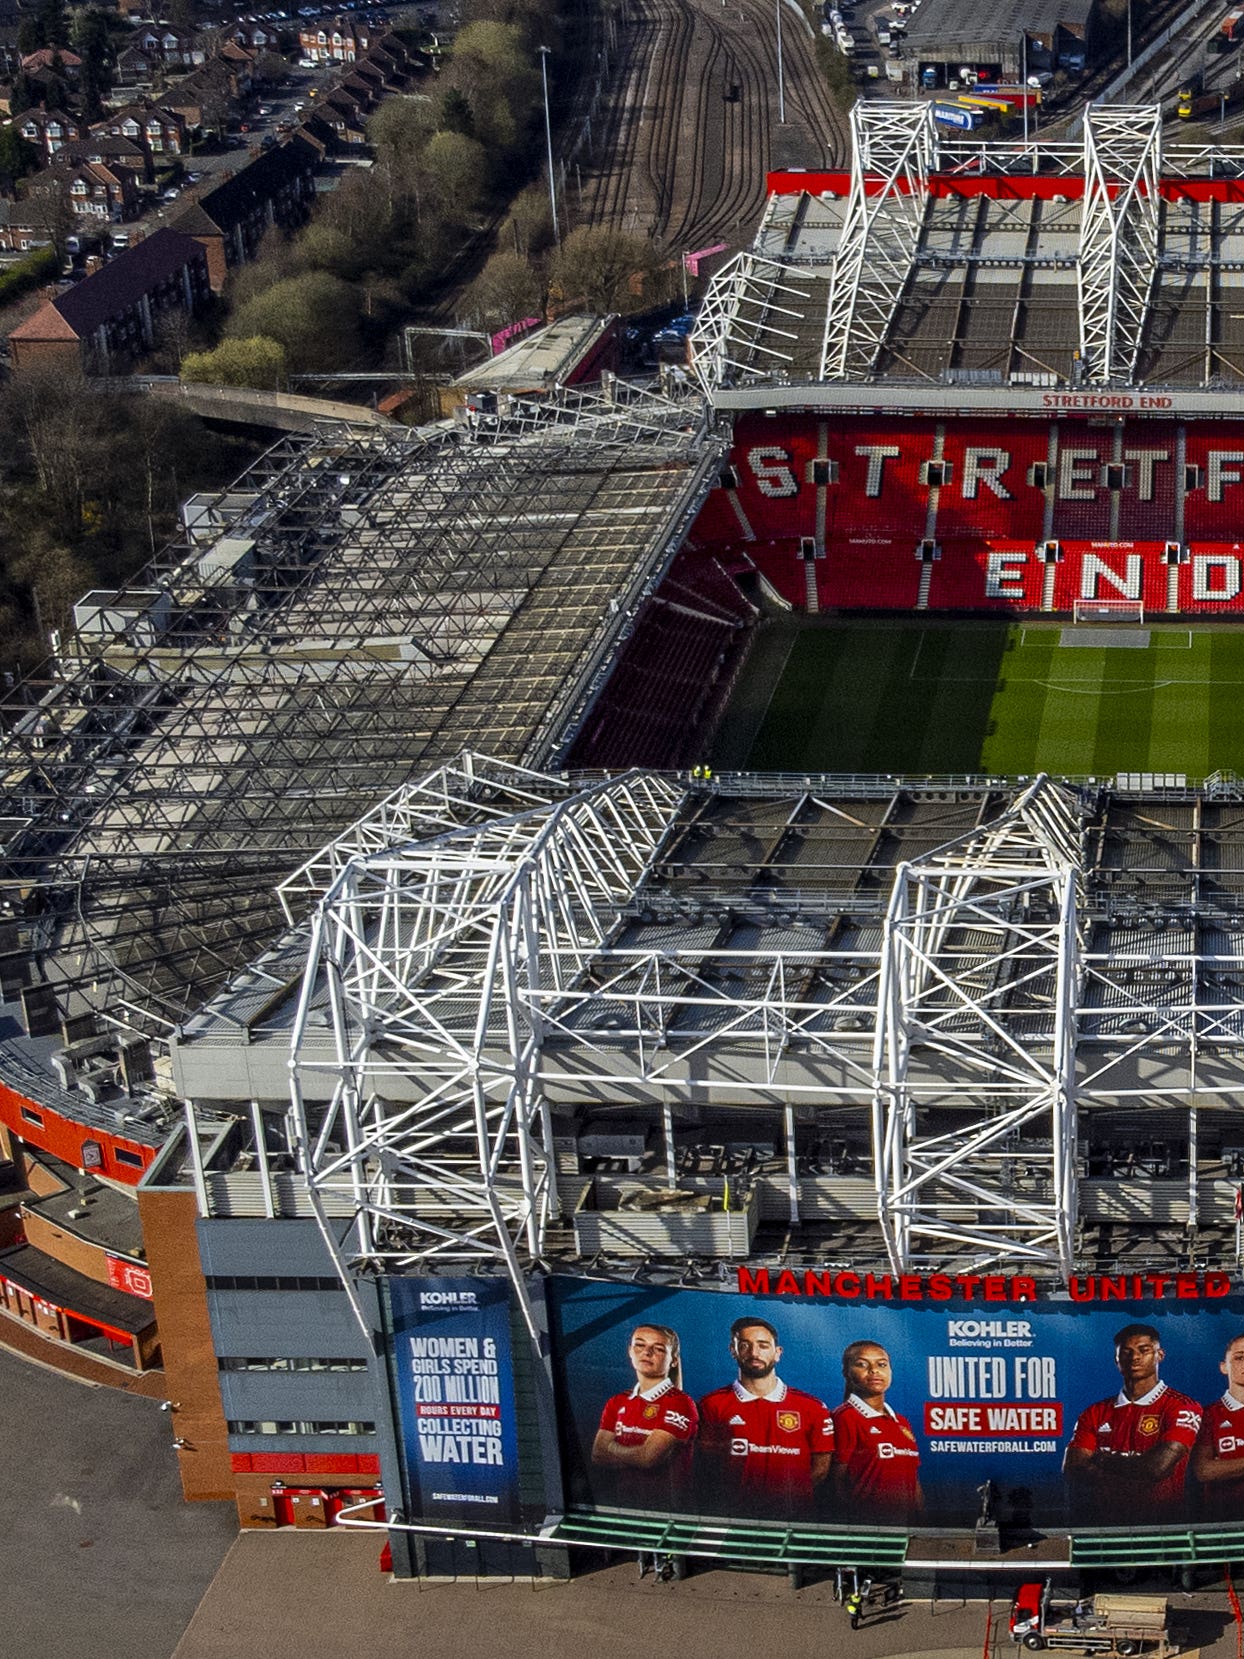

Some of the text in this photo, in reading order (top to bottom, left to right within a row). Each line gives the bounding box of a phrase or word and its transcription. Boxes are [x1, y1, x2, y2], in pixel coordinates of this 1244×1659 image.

[1043, 394, 1173, 409] STRETFORD END
[985, 552, 1241, 602] END
[737, 1265, 1231, 1303] MANCHESTER UNITED
[420, 1292, 478, 1304] KOHLER
[948, 1320, 1032, 1338] KOHLER
[410, 1337, 496, 1358] WOMEN &
[949, 1339, 991, 1348] Believing
[993, 1339, 1002, 1347] in
[412, 1358, 498, 1375] GIRLS SPEND
[928, 1356, 1056, 1399] UNITED FOR
[414, 1375, 500, 1404] 200 MILLION
[420, 1405, 496, 1417] HOURS EVERY DAY
[930, 1407, 1057, 1431] SAFE WATER
[417, 1418, 502, 1437] COLLECTING
[419, 1435, 504, 1465] WATER
[930, 1441, 1057, 1453] SAFEWATERFORALL.COM
[432, 1492, 498, 1504] SAFEWATERFORALL.COM
